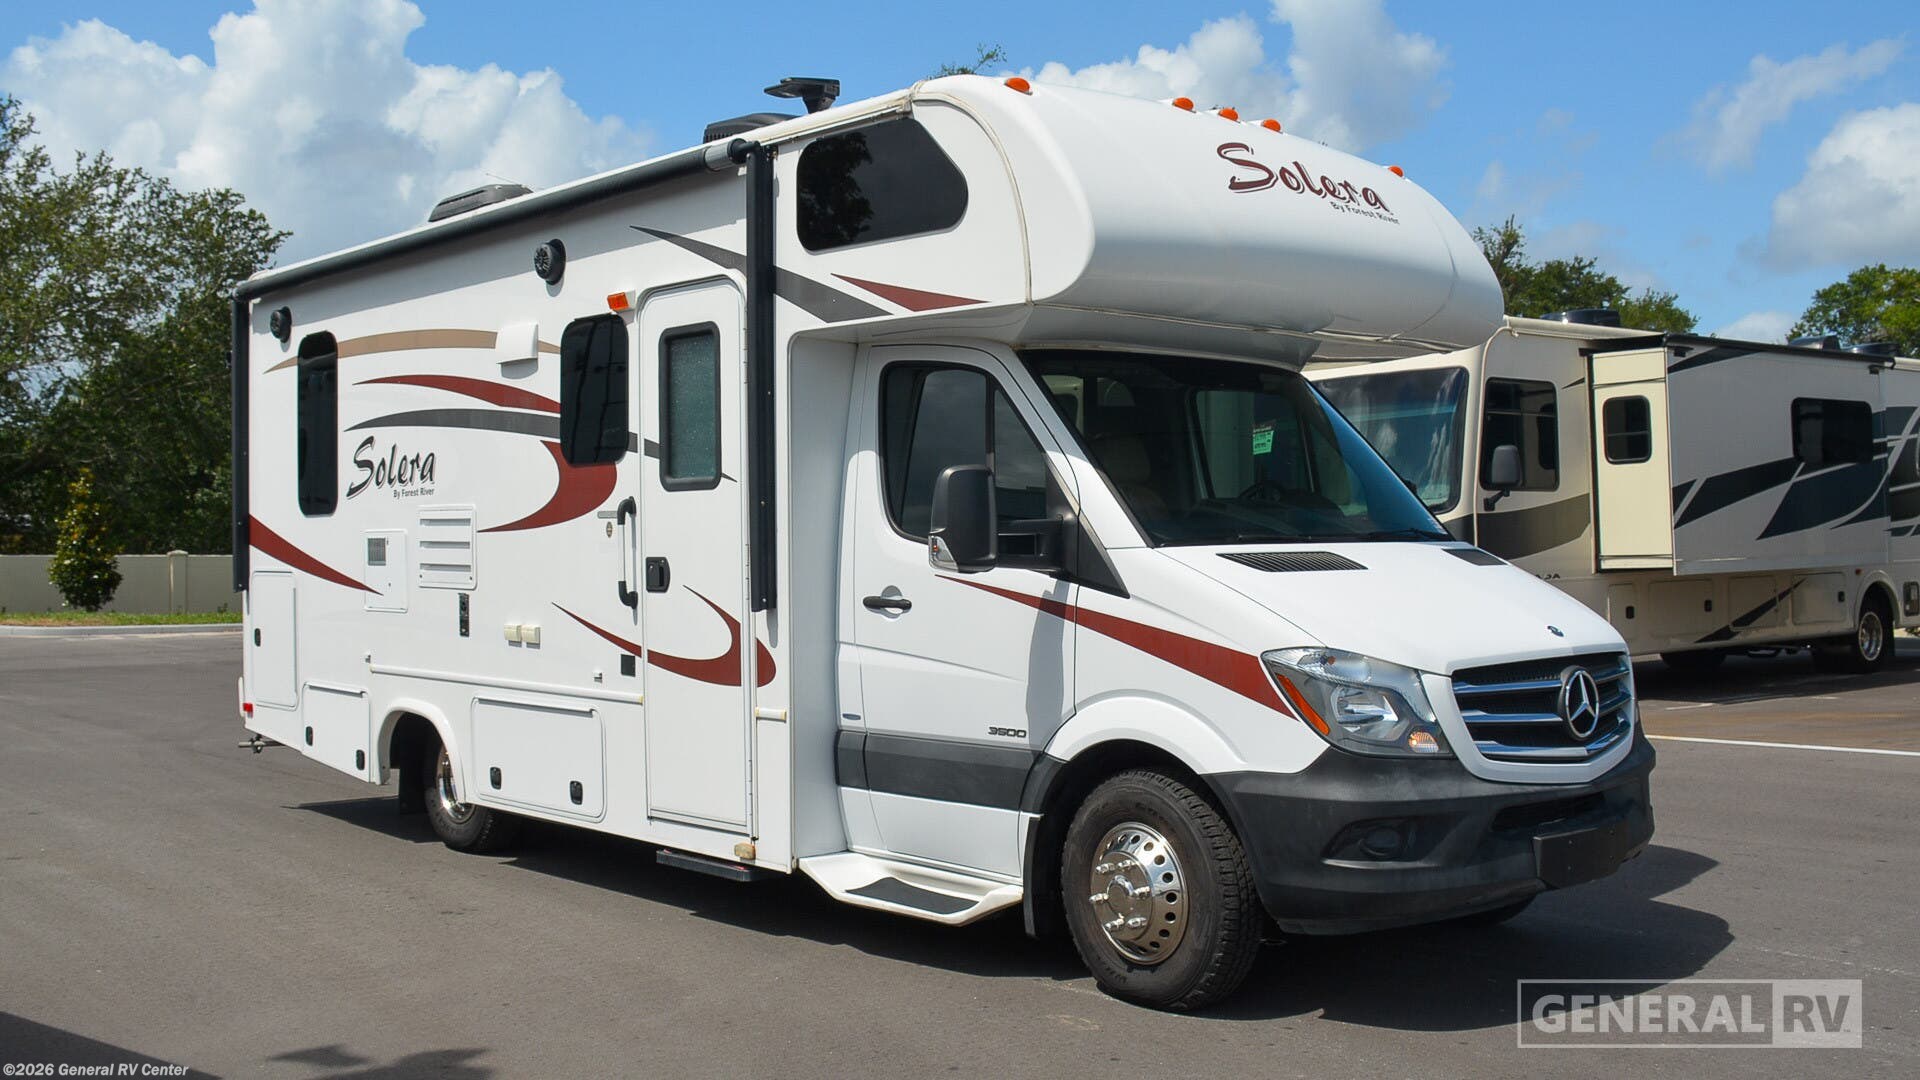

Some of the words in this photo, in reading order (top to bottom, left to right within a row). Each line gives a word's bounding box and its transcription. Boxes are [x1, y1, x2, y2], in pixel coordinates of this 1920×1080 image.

[1217, 142, 1394, 214] Solera
[1330, 201, 1345, 212] By
[346, 435, 436, 500] Solera
[393, 489, 401, 499] By
[401, 488, 419, 497] Forest
[419, 487, 435, 496] River
[988, 726, 1027, 738] 3500
